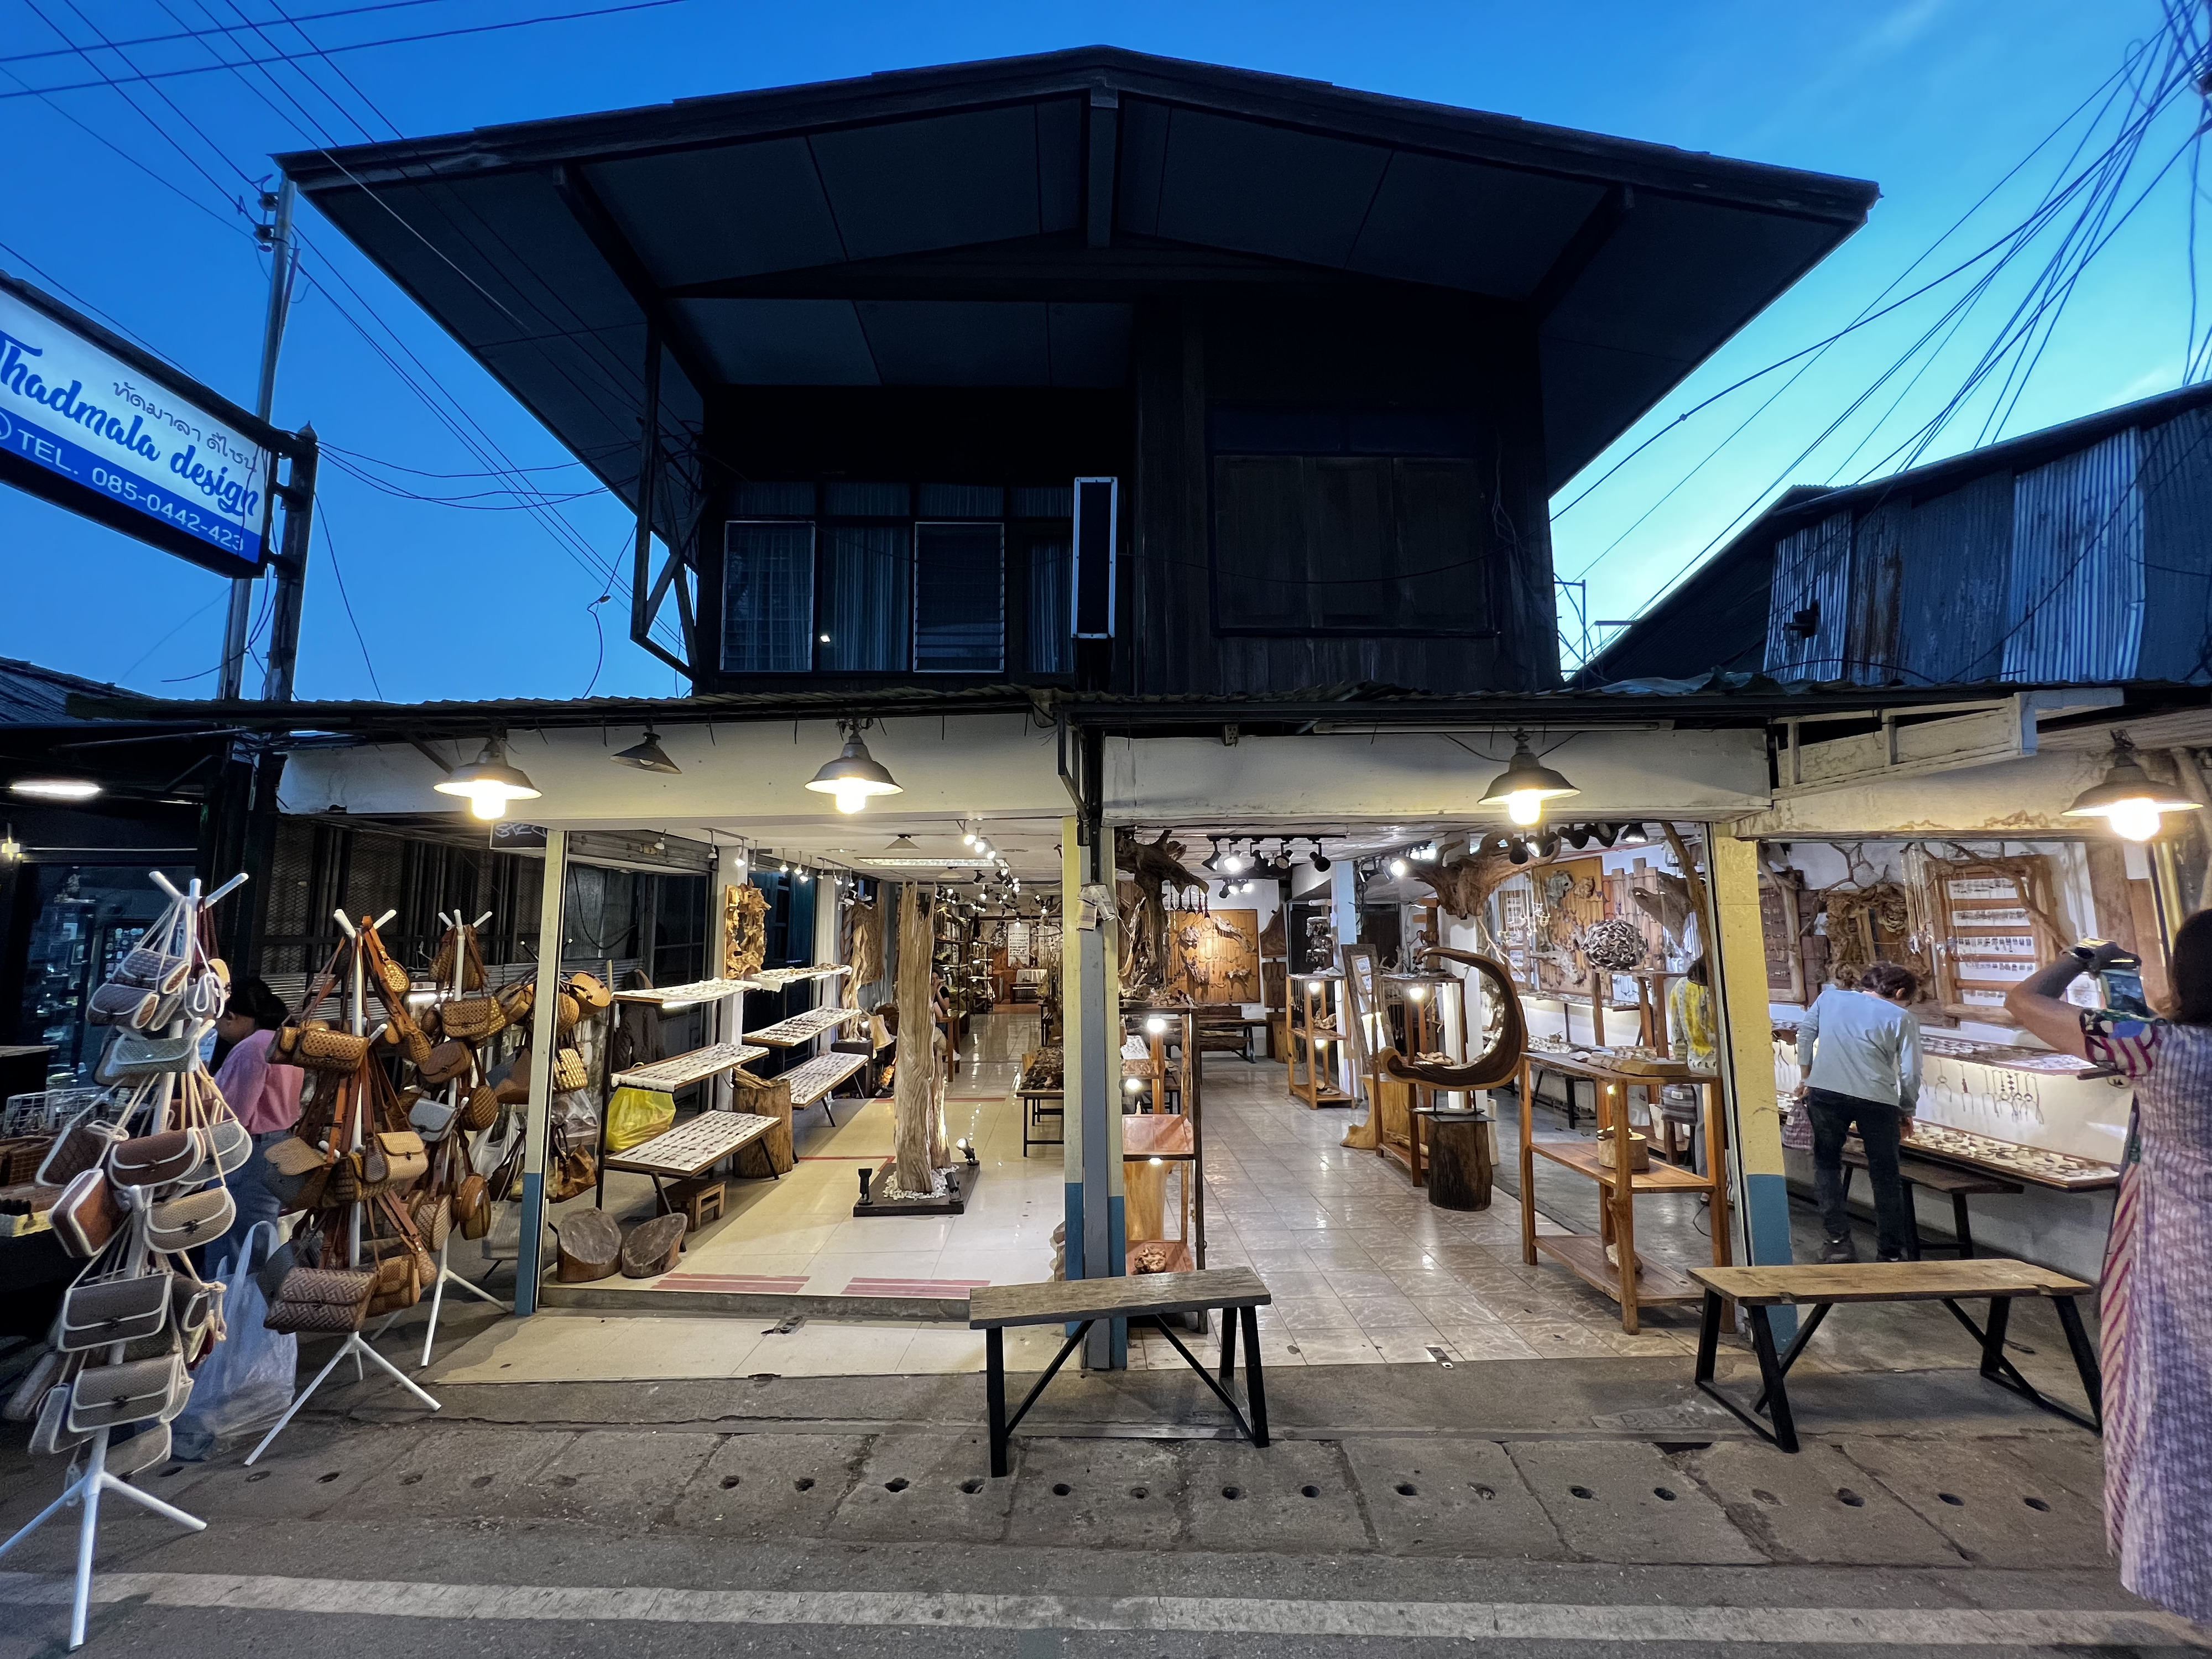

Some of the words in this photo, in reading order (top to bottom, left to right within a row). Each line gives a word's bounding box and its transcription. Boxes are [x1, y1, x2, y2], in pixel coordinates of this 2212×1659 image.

[113, 382, 201, 442] ทัดมาลา
[18, 429, 79, 475] TEL.
[92, 467, 243, 551] 085-0442-423
[170, 445, 259, 517] design
